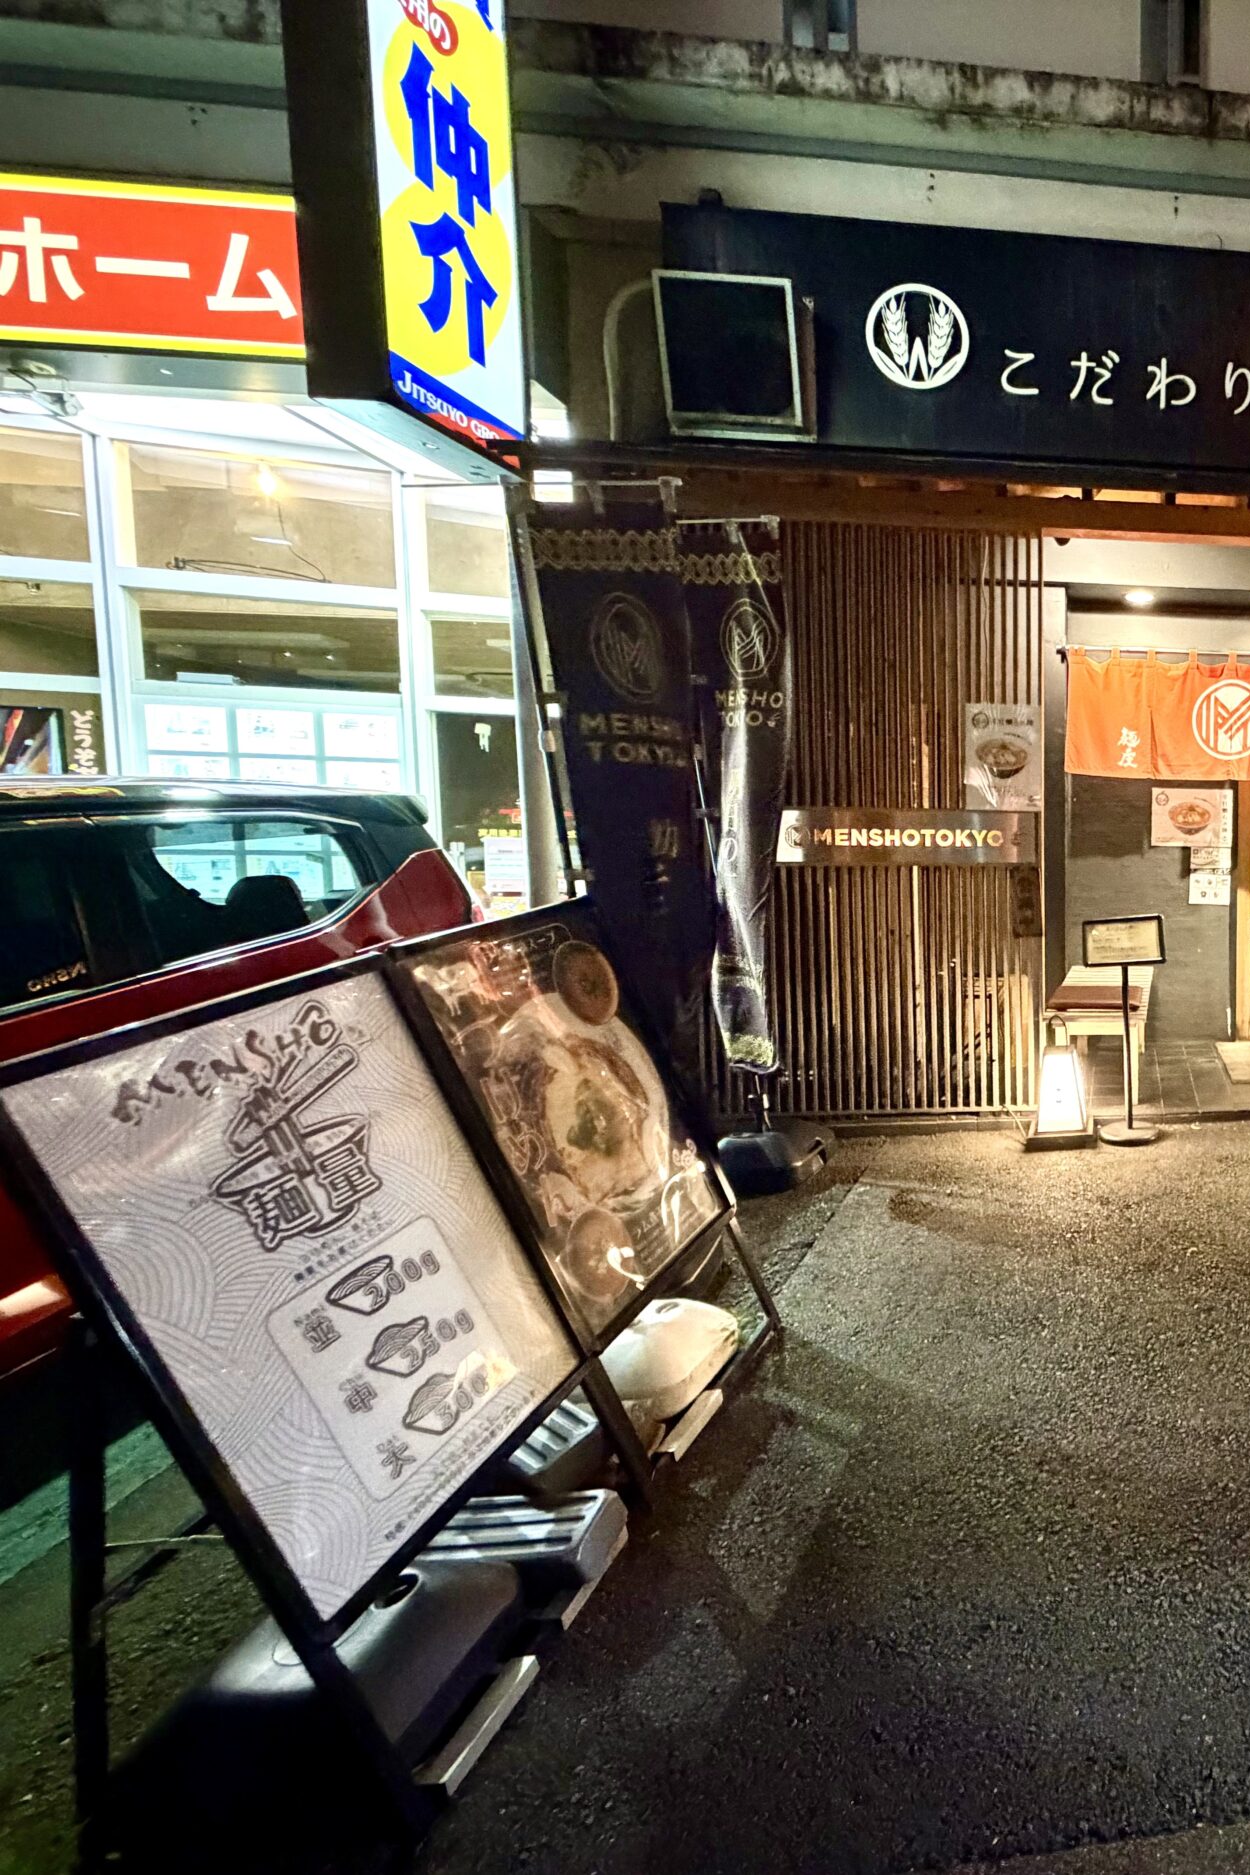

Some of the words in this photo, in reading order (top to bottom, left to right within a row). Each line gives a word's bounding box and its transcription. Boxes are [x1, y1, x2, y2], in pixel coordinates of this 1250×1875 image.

[400, 41, 498, 368] 仲介
[0, 217, 298, 319] ホーム
[363, 1249, 440, 1309] 200g
[399, 1308, 474, 1370] 250g
[434, 1370, 496, 1425] 300
